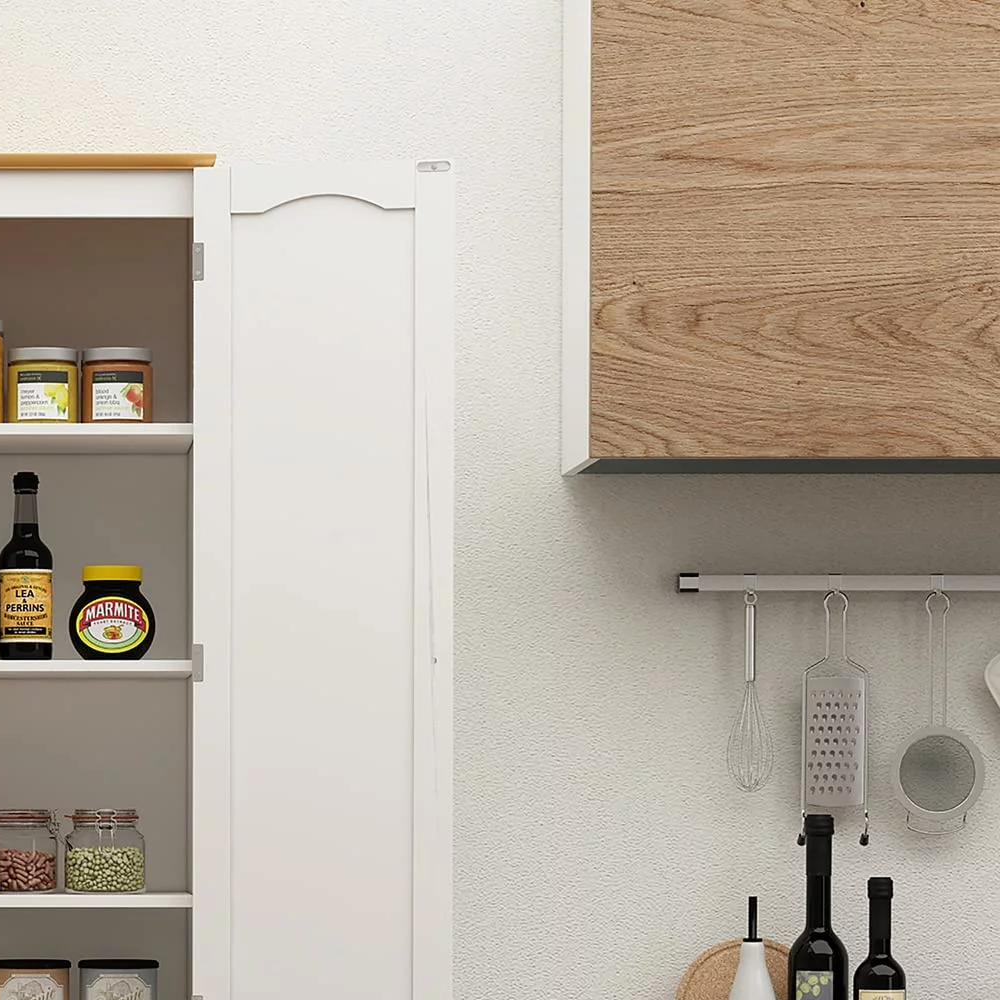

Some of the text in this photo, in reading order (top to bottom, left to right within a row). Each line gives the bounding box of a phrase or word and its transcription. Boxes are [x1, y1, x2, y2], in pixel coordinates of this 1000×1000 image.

[16, 590, 35, 598] LEA
[6, 604, 45, 612] PERRINS
[86, 602, 140, 622] MARMITE
